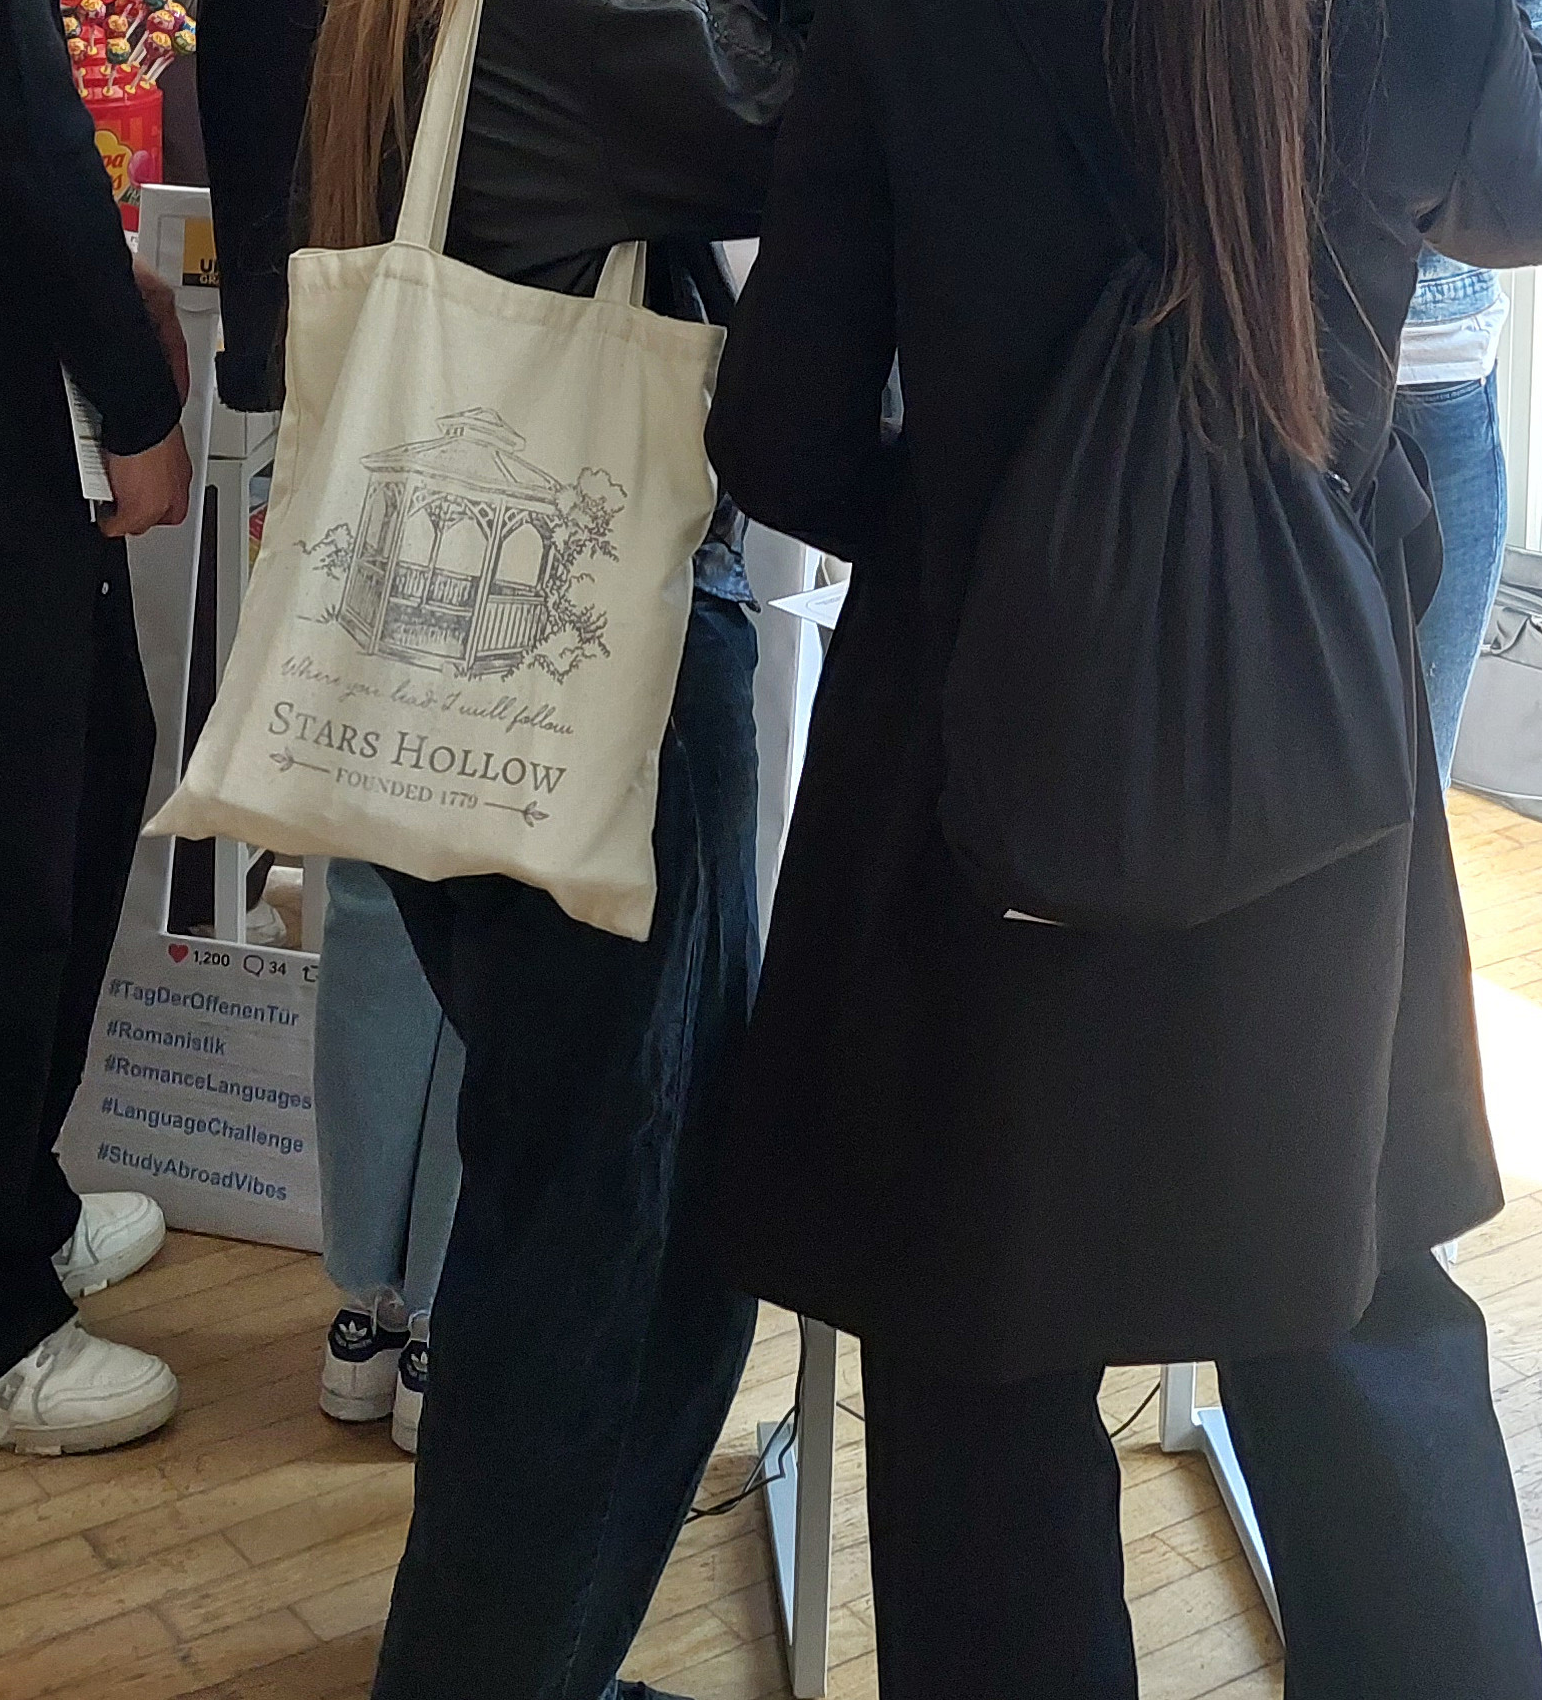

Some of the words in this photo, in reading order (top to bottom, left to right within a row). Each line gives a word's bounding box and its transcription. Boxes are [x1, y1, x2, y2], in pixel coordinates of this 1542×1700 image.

[335, 766, 433, 803] FOUNDED
[439, 789, 479, 810] 1779
[193, 949, 231, 967] 1,200
[268, 960, 287, 976] 34
[109, 978, 300, 1027] #TagDerOffenenTür
[107, 1020, 228, 1057] #Romanistik
[104, 1053, 313, 1111] #RomanceLanguages
[101, 1096, 304, 1155] #LanguageChallenge
[97, 1141, 288, 1202] #StudyAbroadVibes
